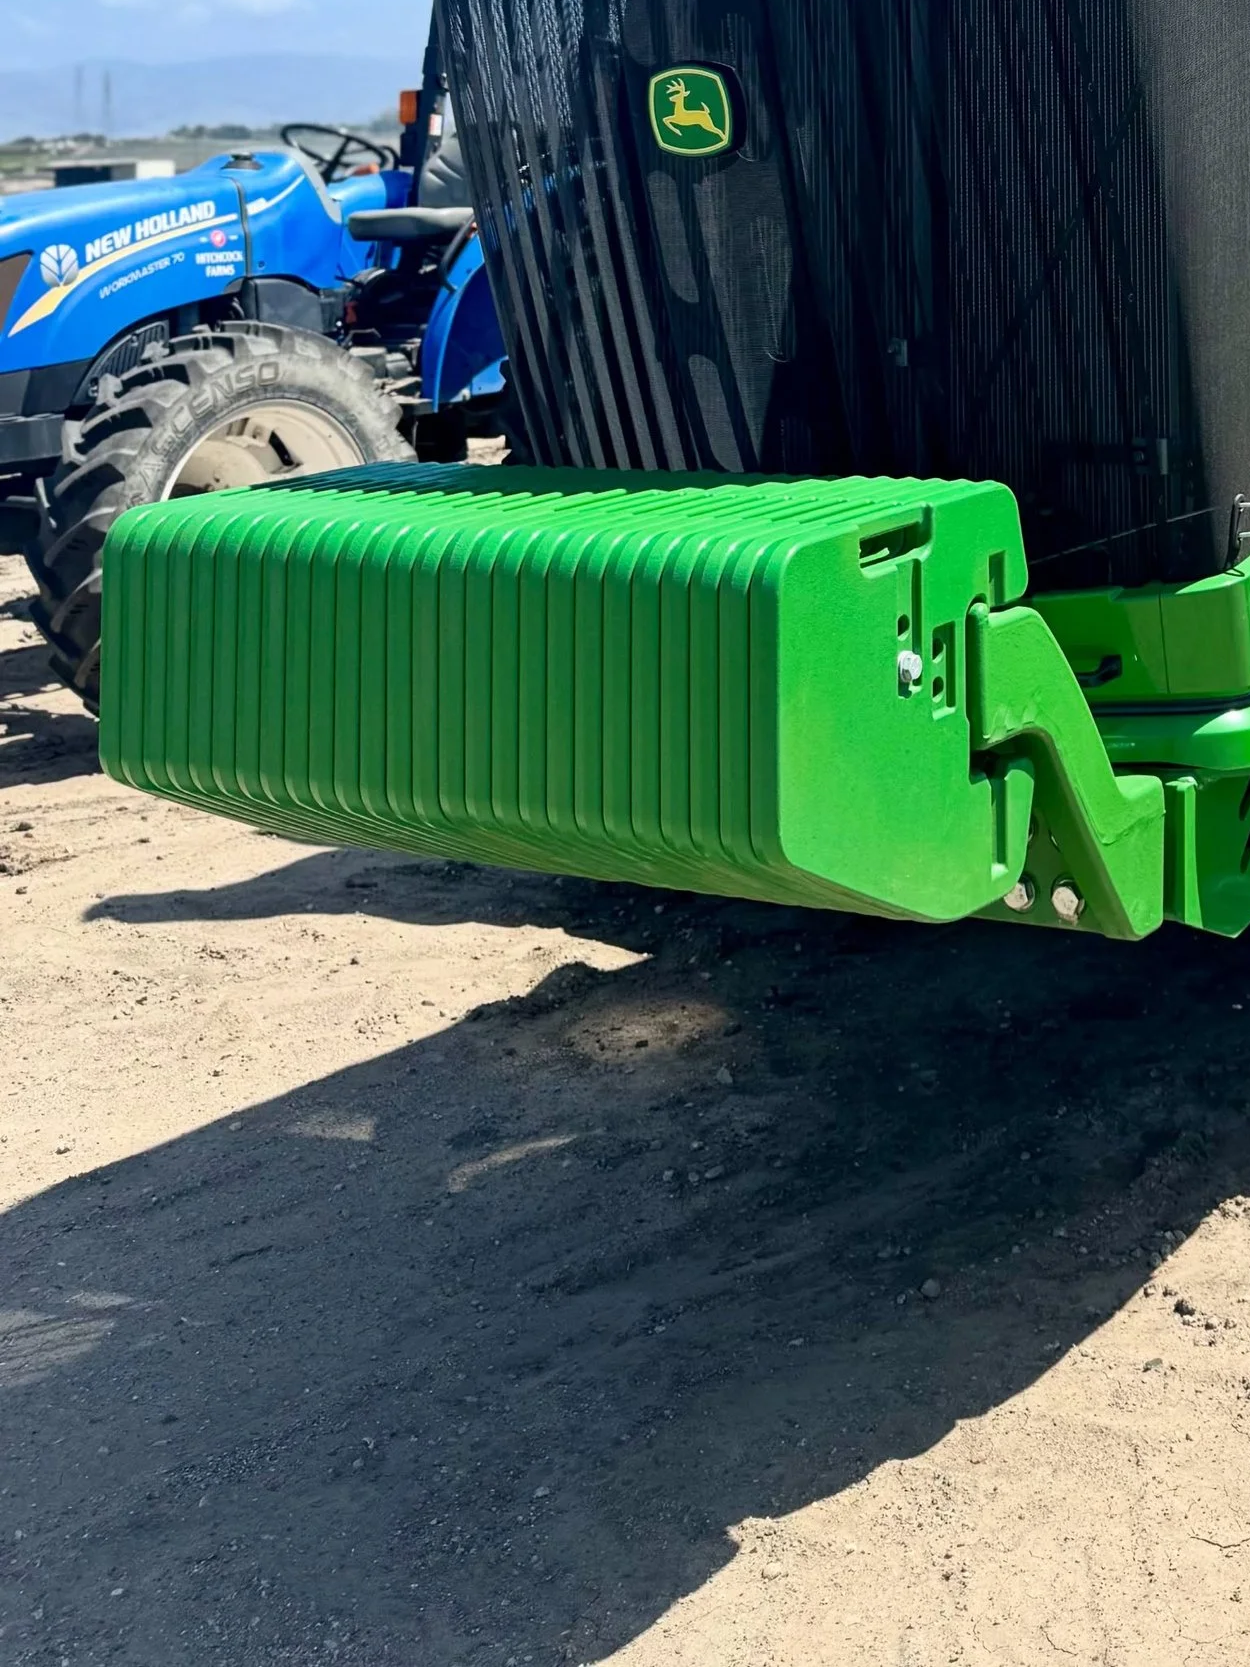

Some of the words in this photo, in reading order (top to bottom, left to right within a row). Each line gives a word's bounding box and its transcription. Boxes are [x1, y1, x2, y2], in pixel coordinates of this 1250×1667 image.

[85, 224, 132, 263] NEW
[135, 200, 216, 238] HOLLAND
[99, 256, 171, 300] WORKMASTER
[172, 252, 185, 264] 70
[205, 264, 235, 277] FARMS
